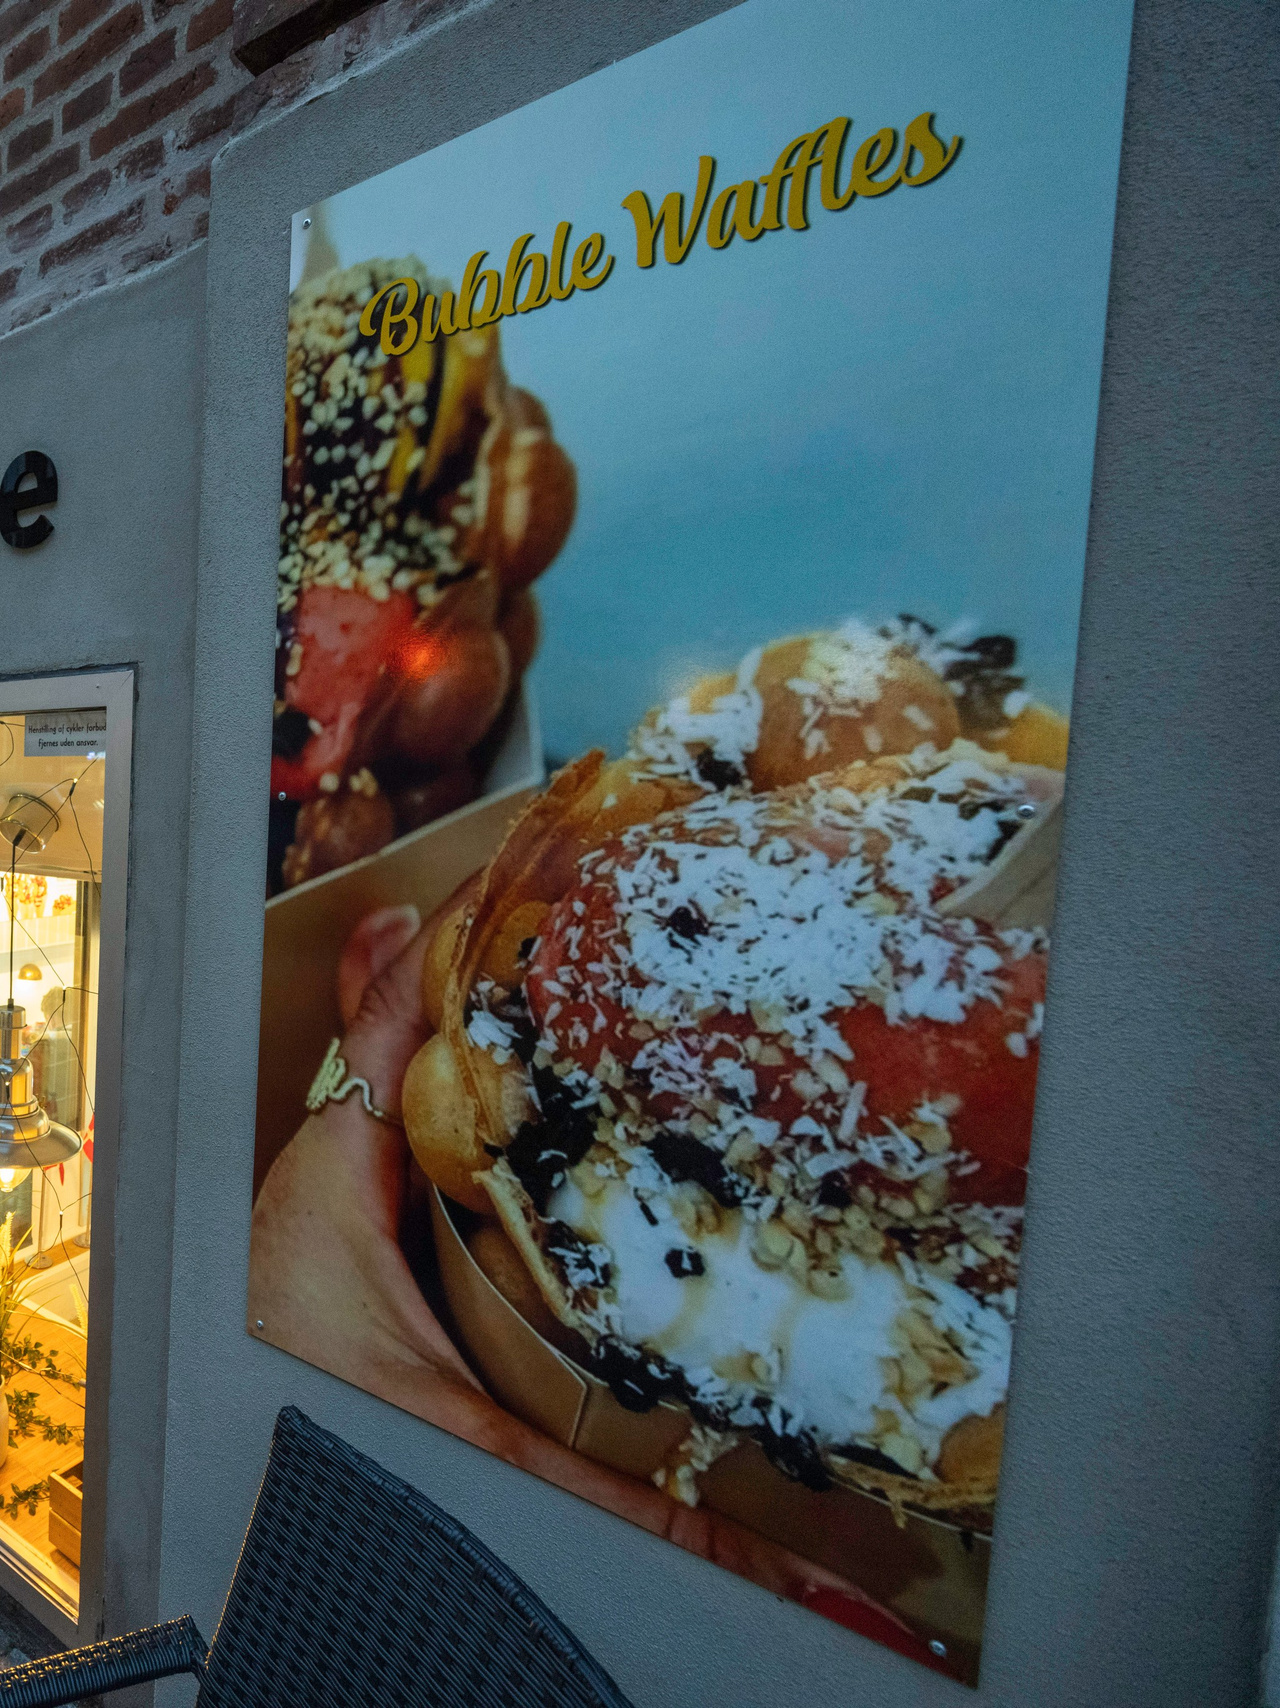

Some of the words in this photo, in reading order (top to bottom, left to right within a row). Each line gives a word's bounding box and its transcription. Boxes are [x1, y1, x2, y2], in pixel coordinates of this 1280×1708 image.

[359, 221, 615, 356] Bubble
[621, 111, 964, 268] Waffles
[66, 723, 85, 734] cykler
[60, 738, 74, 747] uden
[76, 739, 98, 747] ansvar.
